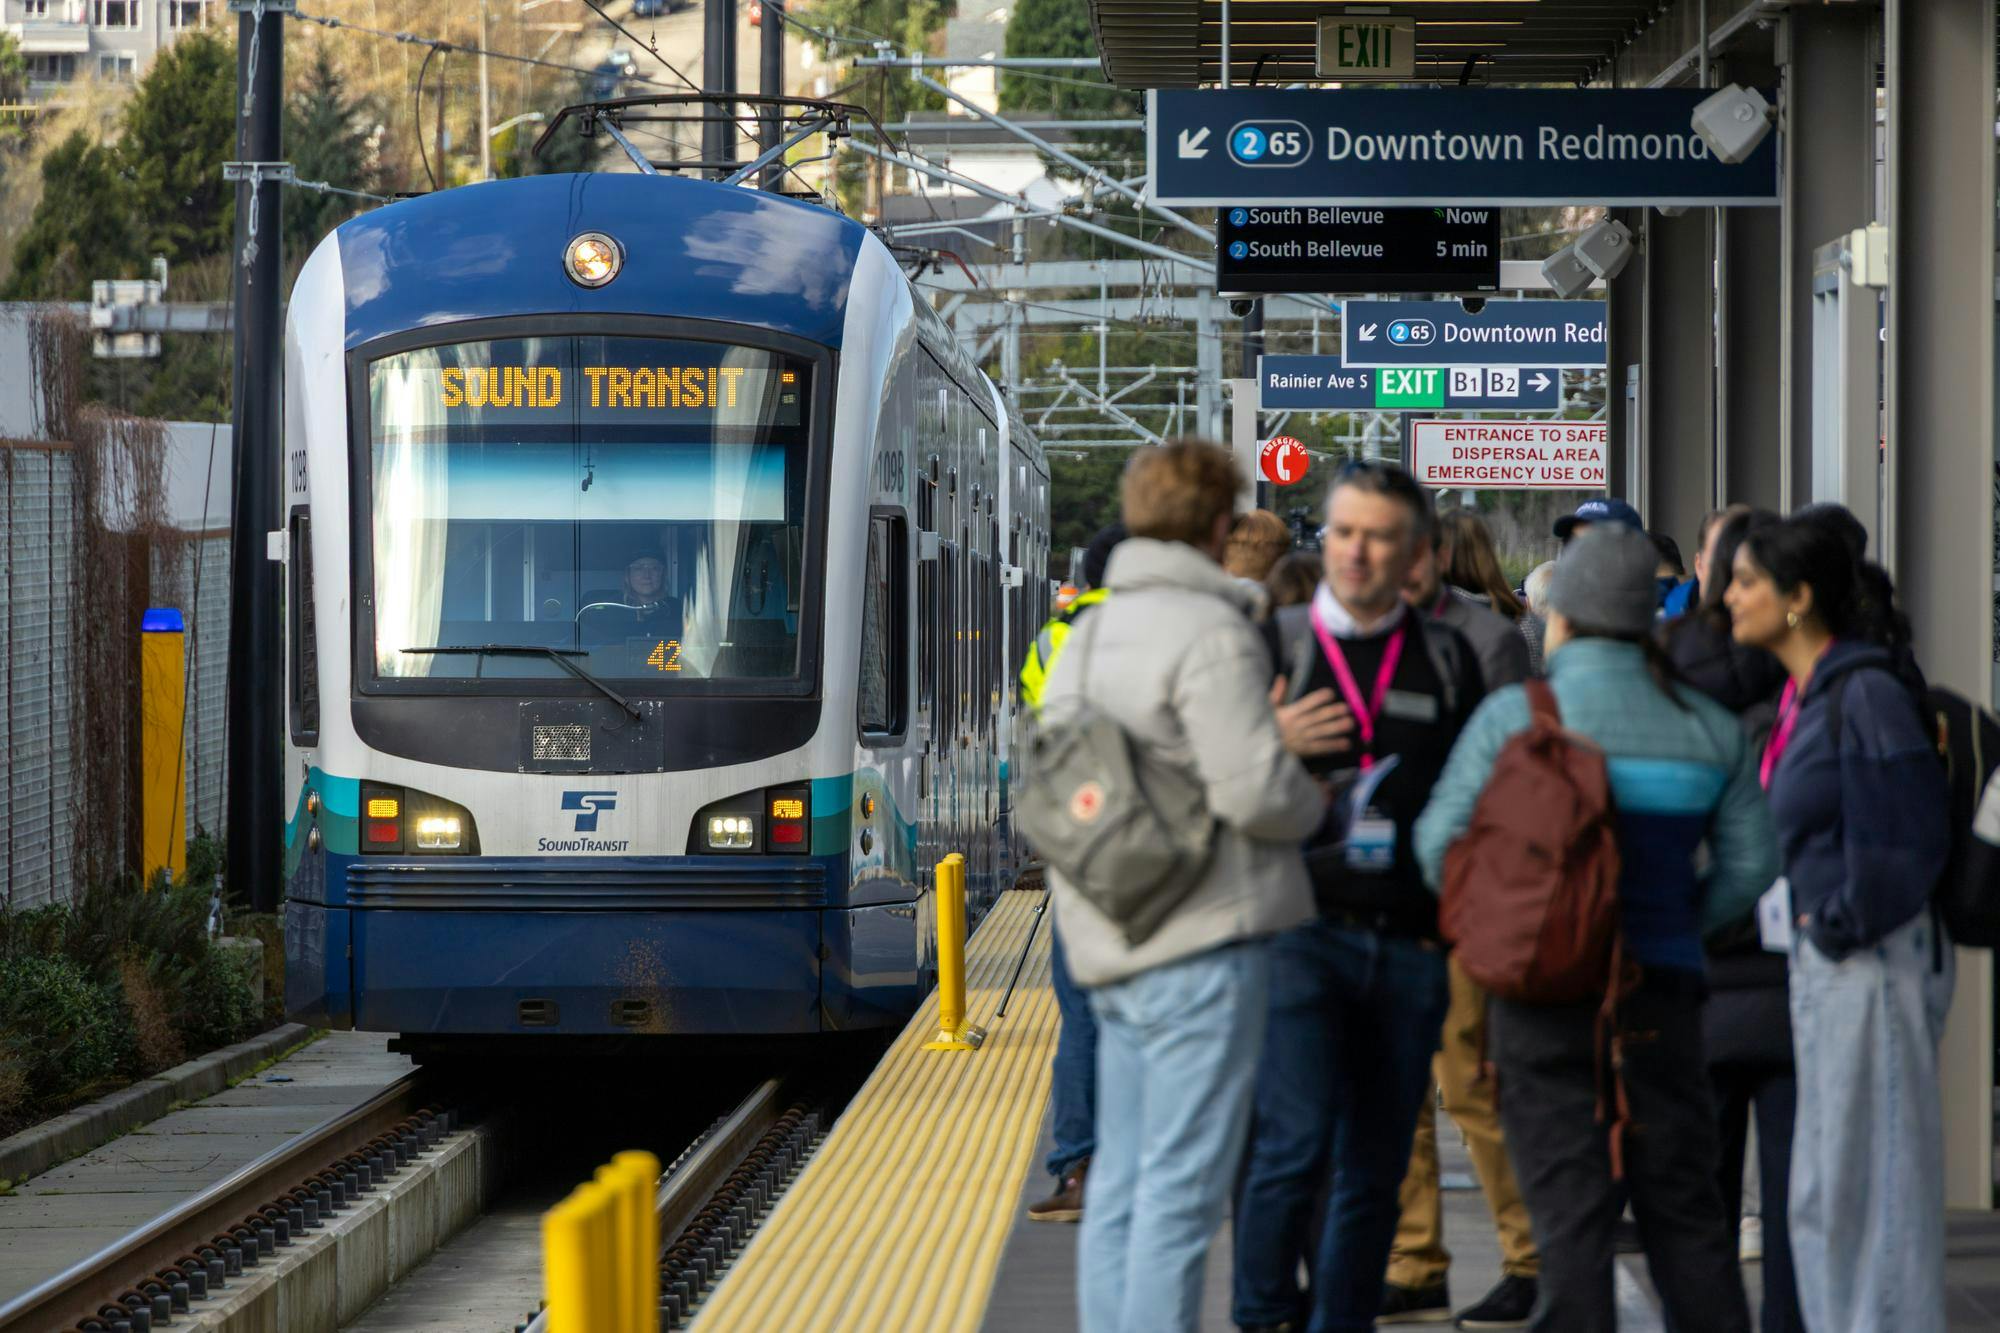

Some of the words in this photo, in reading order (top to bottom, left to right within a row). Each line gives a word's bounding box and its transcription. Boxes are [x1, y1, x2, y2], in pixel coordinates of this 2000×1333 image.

[1338, 24, 1395, 67] EXIT
[1242, 132, 1258, 155] 2
[1269, 132, 1301, 155] 65
[1327, 126, 1524, 161] Downtown
[1234, 211, 1243, 224] 2
[1249, 208, 1301, 224] South
[1307, 208, 1384, 224] Bellevue
[1446, 208, 1488, 224] Now
[1234, 244, 1243, 257] 2
[1249, 240, 1301, 257] South
[1307, 240, 1384, 257] Bellevue
[1436, 241, 1446, 257] 5
[1452, 240, 1488, 257] min
[1395, 326, 1405, 339] 2
[1411, 326, 1430, 339] 65
[1444, 322, 1557, 343] Downtown
[1565, 321, 1607, 343] Red
[440, 367, 561, 407] SOUND
[584, 367, 744, 407] TRANSIT
[1269, 373, 1322, 388] Rainier
[1327, 373, 1355, 388] Ave
[1359, 373, 1368, 388] S
[1382, 370, 1437, 394] EXIT
[1454, 372, 1478, 392] B1
[1491, 372, 1515, 392] B2
[1445, 428, 1534, 441] ENTRANCE
[1540, 429, 1561, 442] TO
[1263, 437, 1307, 457] EMERGENCY
[1452, 447, 1548, 461] DISPERSAL
[1553, 448, 1600, 461] AREA
[1427, 466, 1535, 479] EMERGENCY
[1541, 467, 1574, 480] USE
[647, 640, 681, 670] 42
